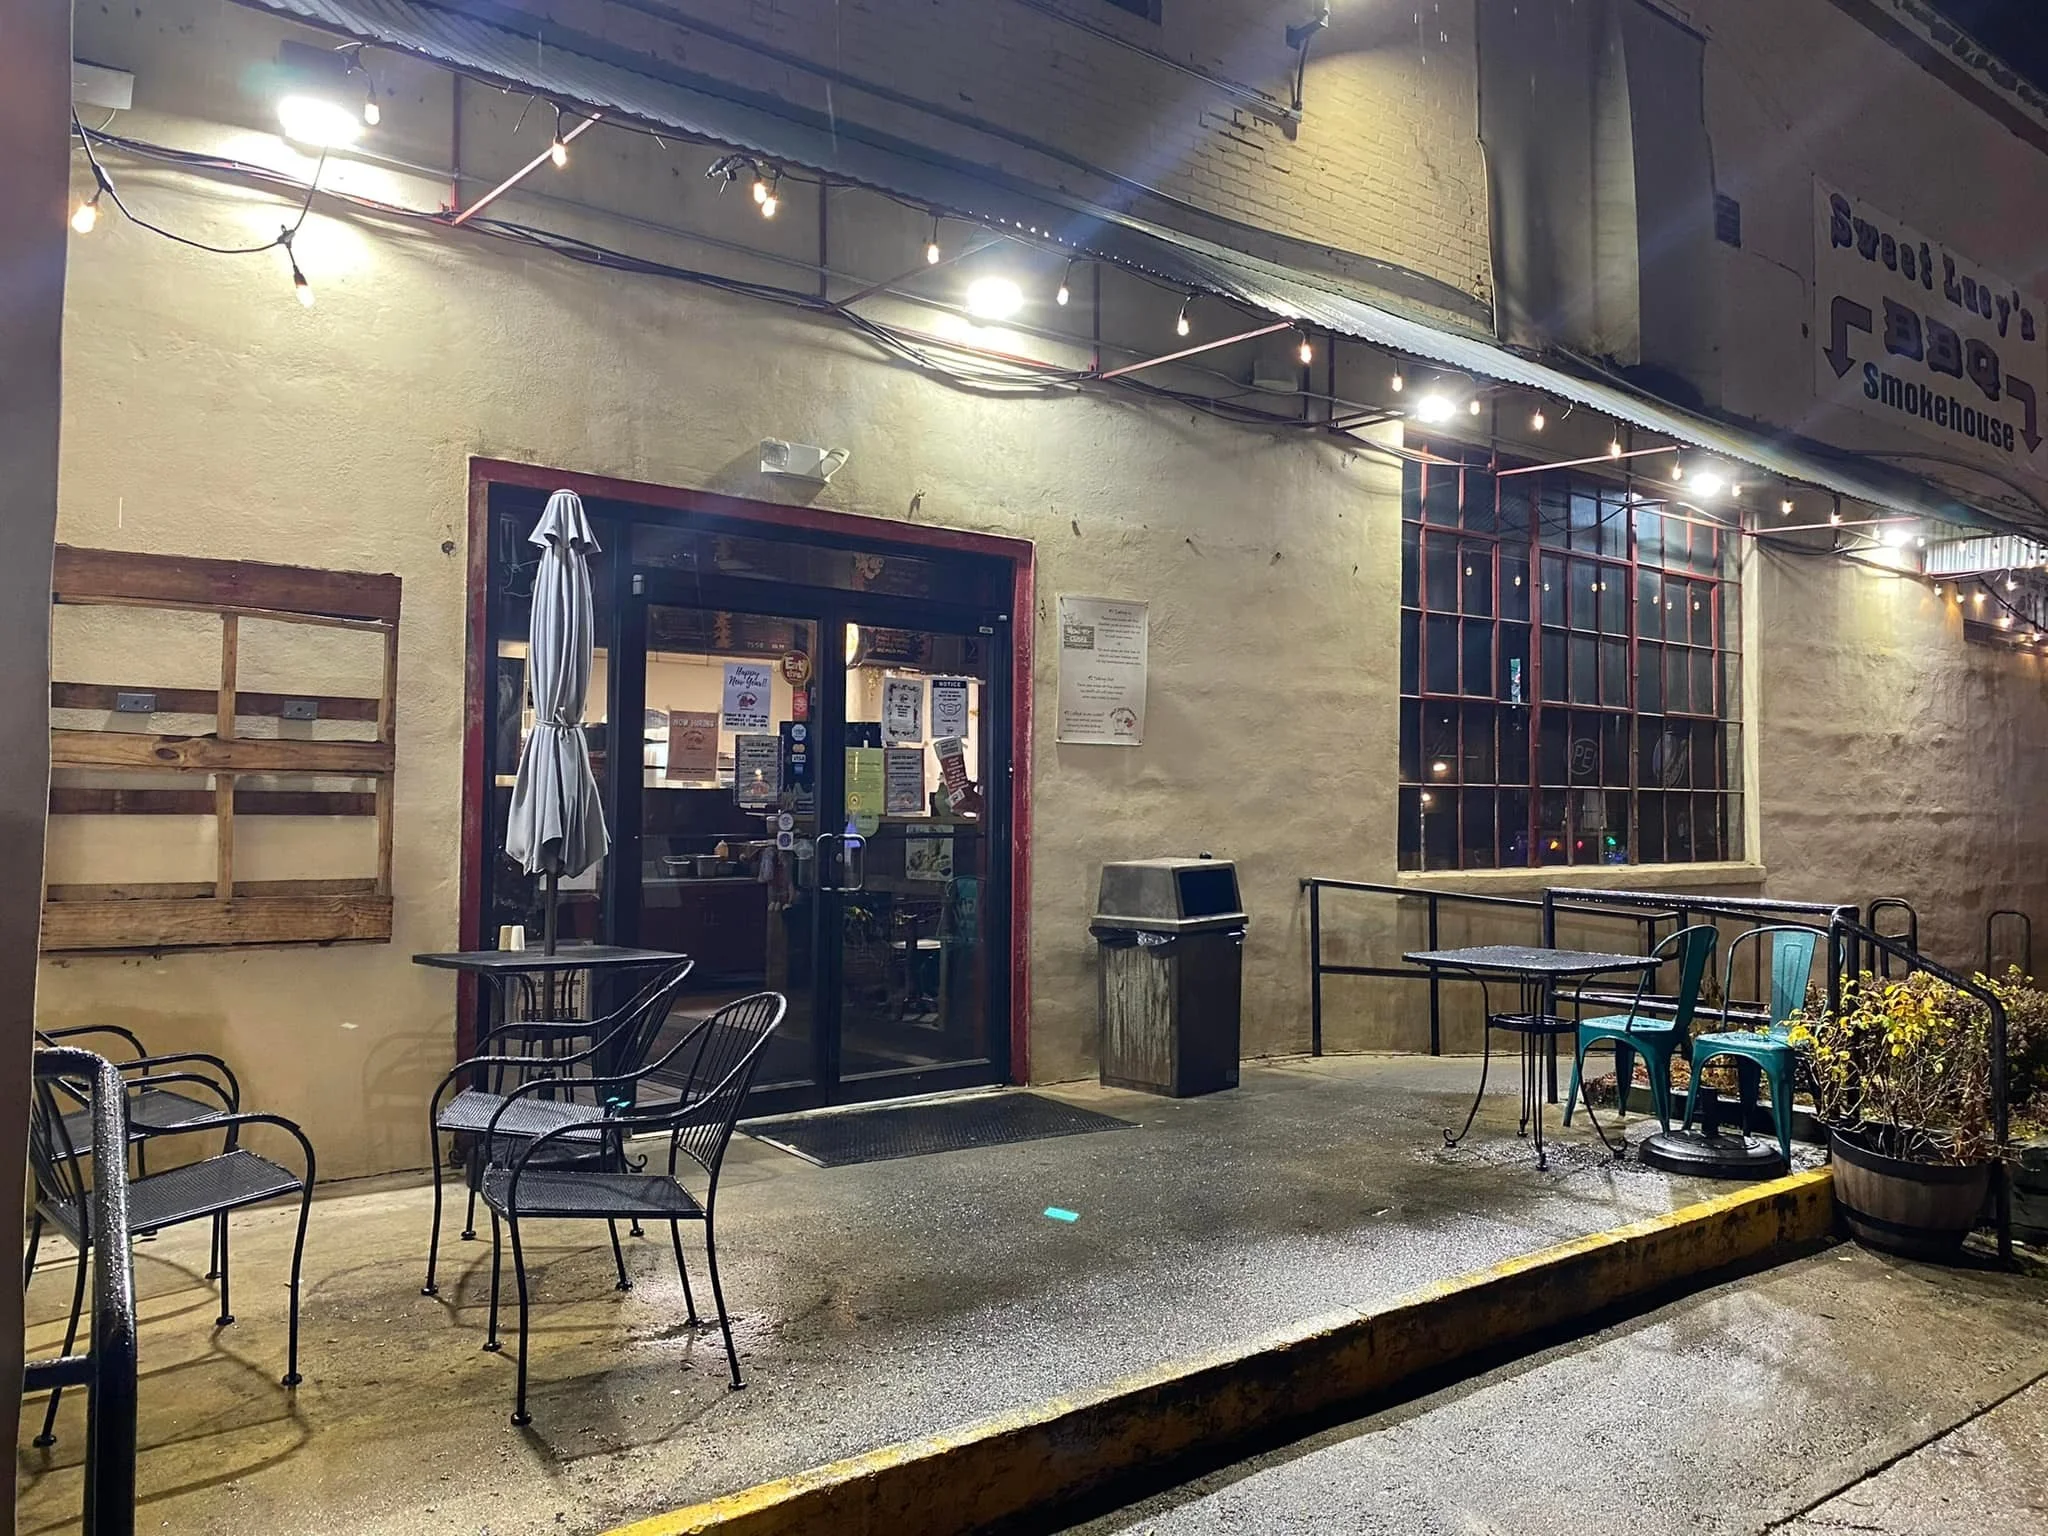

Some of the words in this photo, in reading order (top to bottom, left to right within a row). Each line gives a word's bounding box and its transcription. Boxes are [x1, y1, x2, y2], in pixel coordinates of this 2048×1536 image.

[1830, 193, 1933, 290] Sweet
[1942, 253, 2035, 341] Lucy's
[1882, 296, 2002, 402] BBQ
[1863, 362, 2015, 452] Smokehouse
[728, 675, 745, 687] New
[735, 666, 760, 681] Happy
